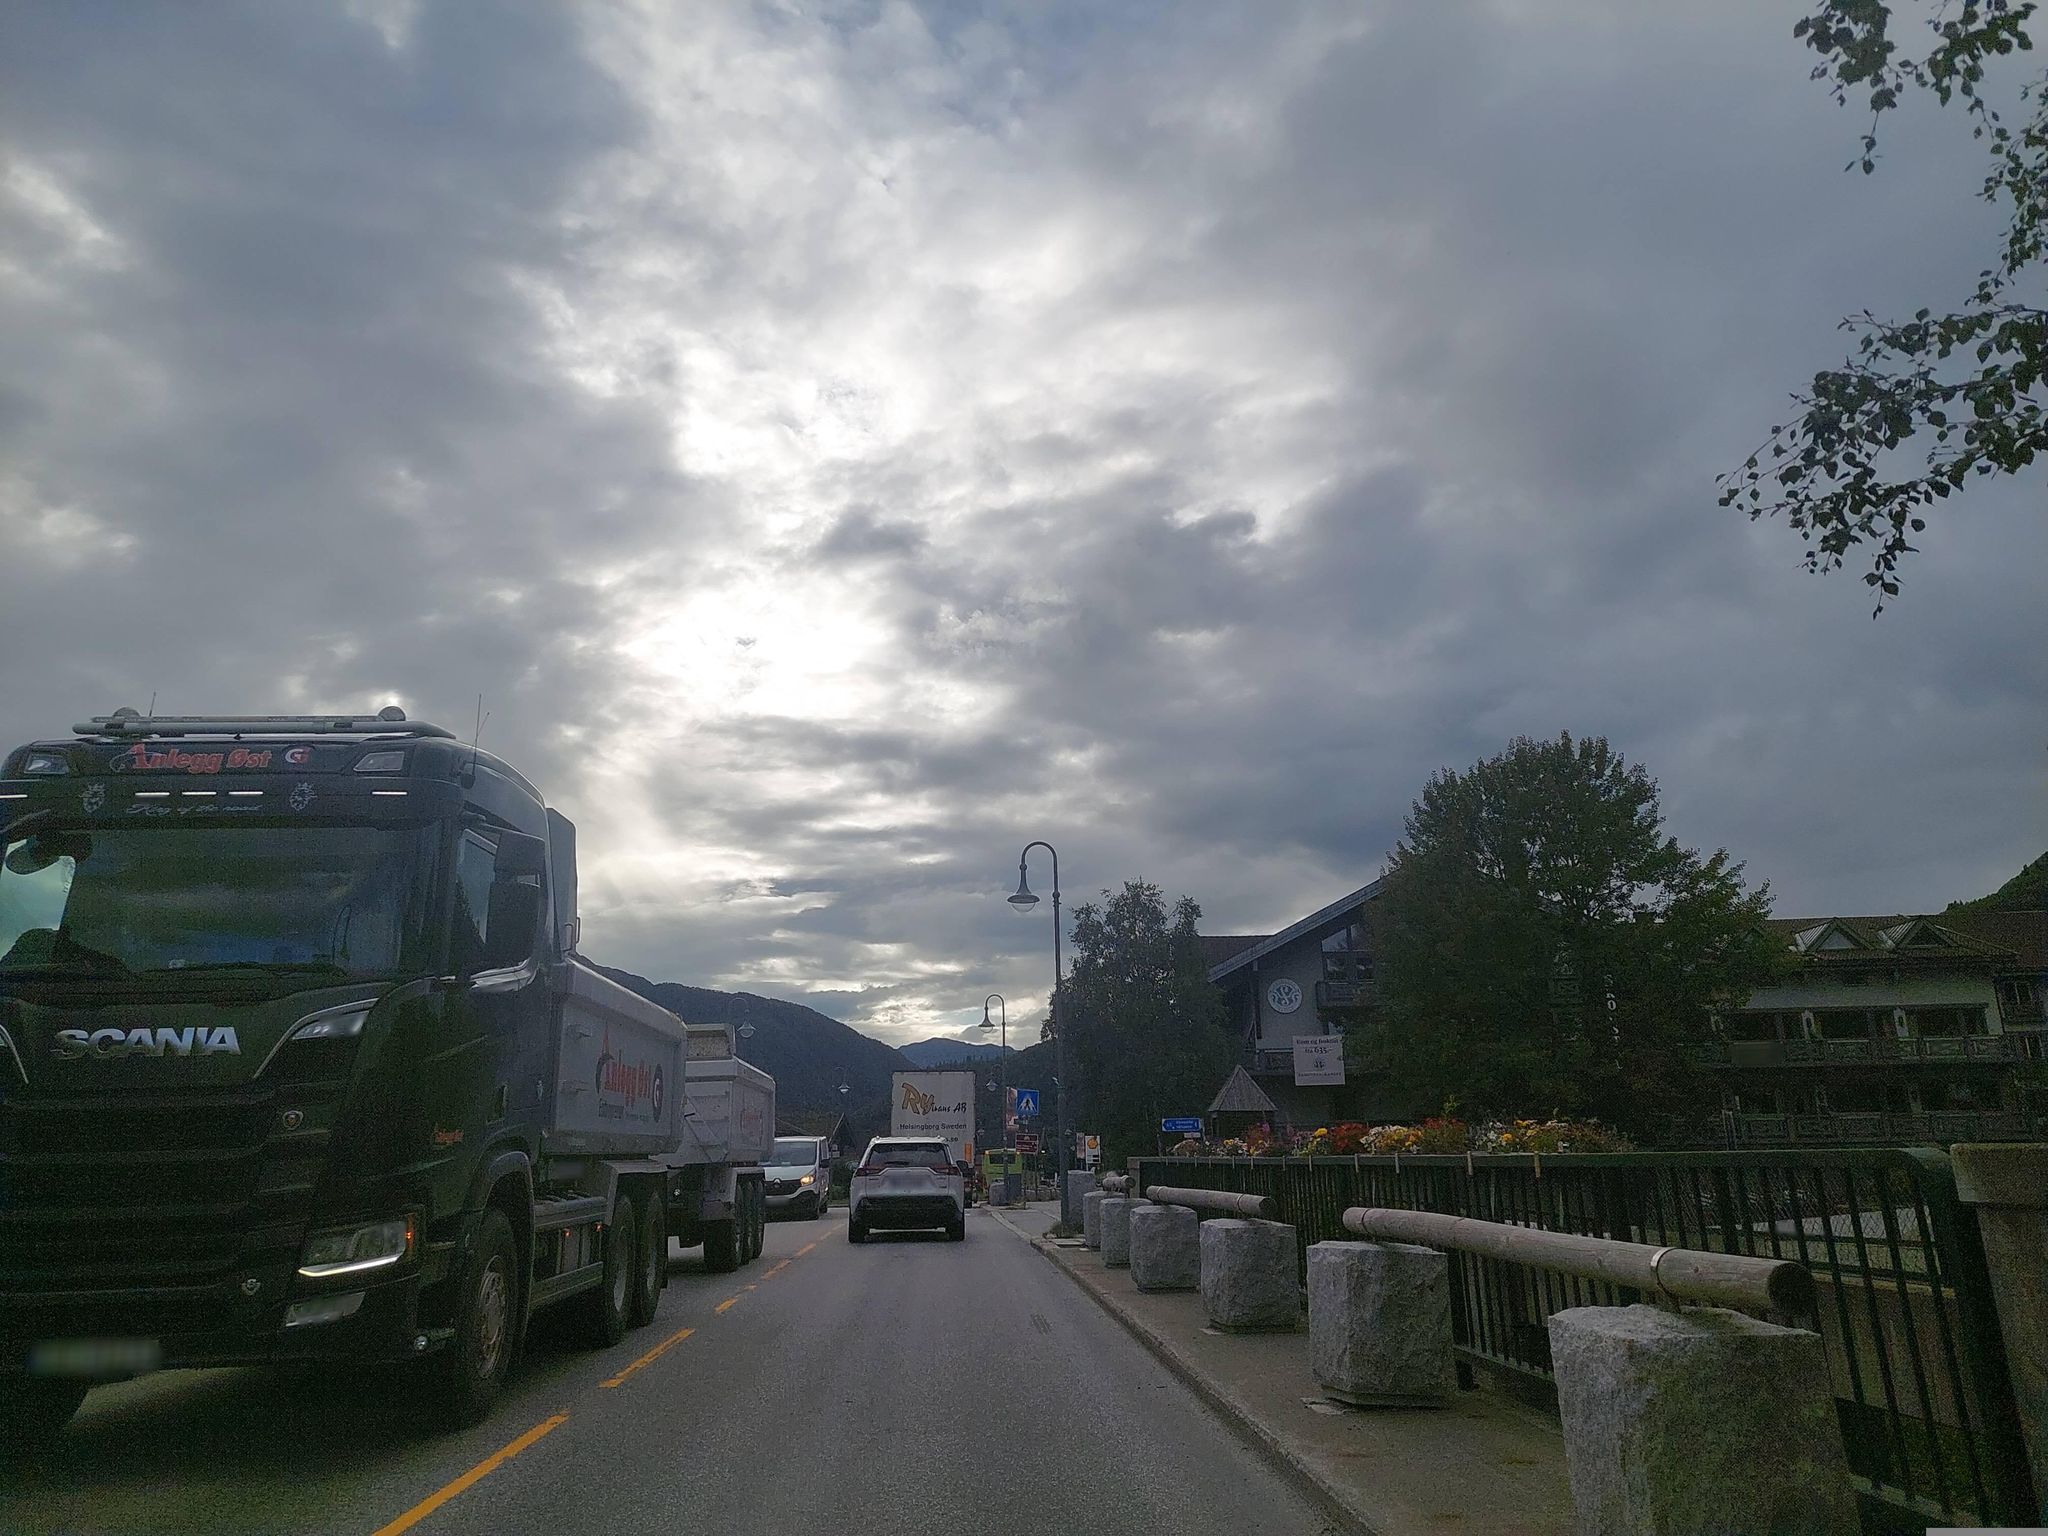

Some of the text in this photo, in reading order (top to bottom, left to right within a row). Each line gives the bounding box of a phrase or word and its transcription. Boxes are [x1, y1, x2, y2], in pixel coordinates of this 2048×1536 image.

[126, 743, 273, 774] Anlegg Øst
[50, 1026, 242, 1060] SCANIA
[953, 1102, 967, 1114] AB
[899, 1122, 967, 1131] Helsingborg Sweden
